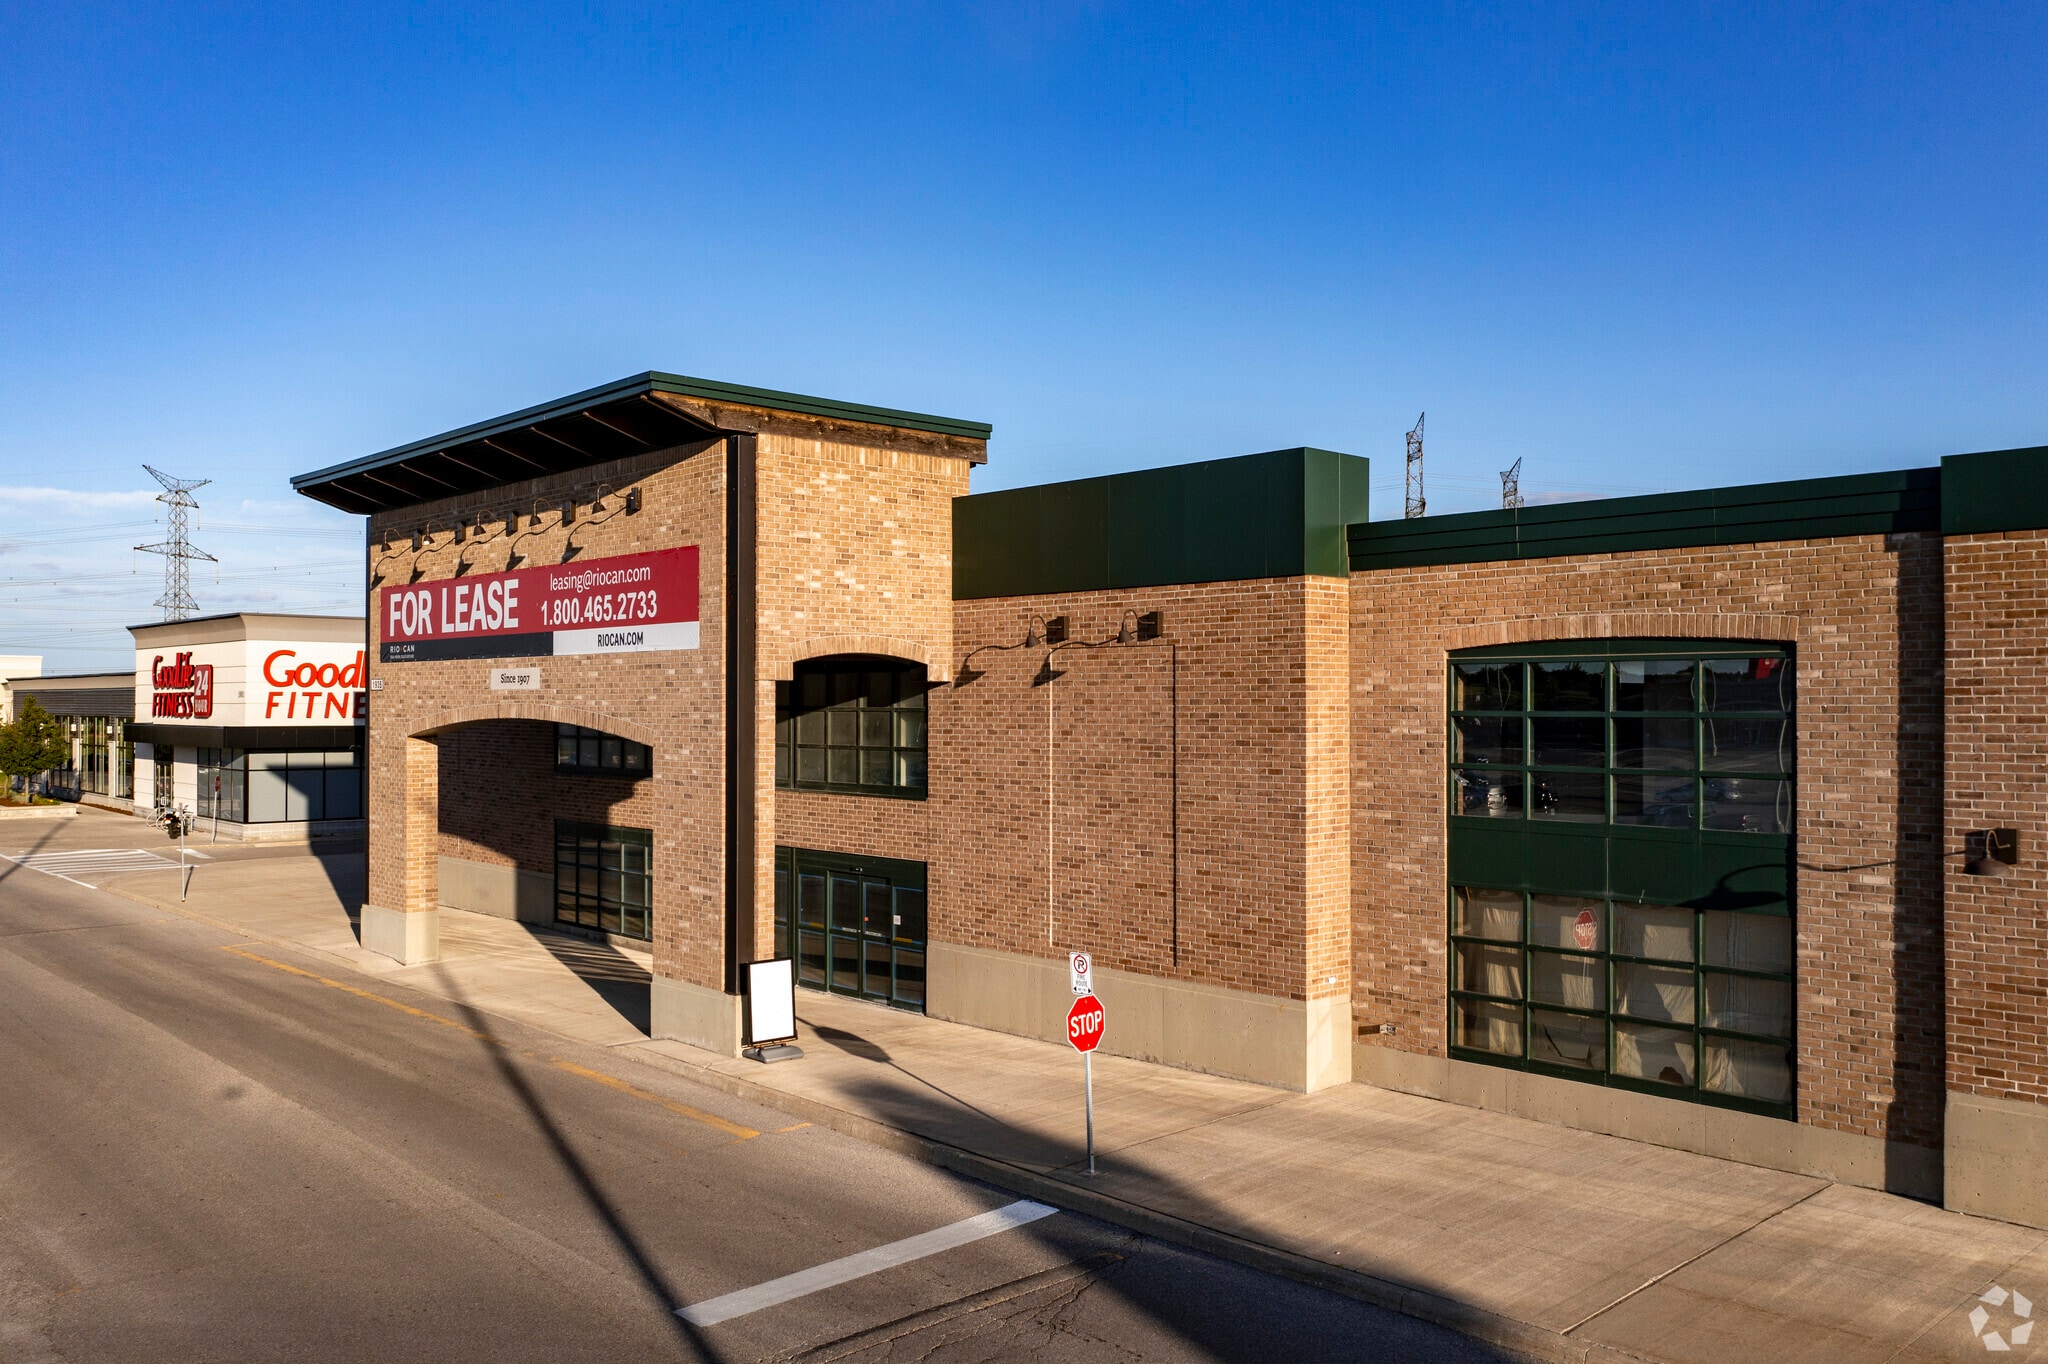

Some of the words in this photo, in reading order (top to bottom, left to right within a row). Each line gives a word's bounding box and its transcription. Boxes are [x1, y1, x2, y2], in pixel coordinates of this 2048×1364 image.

[550, 566, 651, 593] leasing@riocan.com
[389, 590, 433, 637] FOR
[441, 579, 519, 633] LEASE
[541, 590, 658, 626] 1.800.465.2733
[390, 645, 400, 653] RIO
[403, 644, 415, 653] CAN
[597, 631, 644, 648] RIOCAN.COM
[195, 670, 209, 696] 24
[500, 673, 516, 684] Since
[517, 675, 530, 685] 1907
[152, 692, 194, 719] FITNESS
[195, 699, 208, 713] HOUR
[1070, 1010, 1102, 1038] STOP
